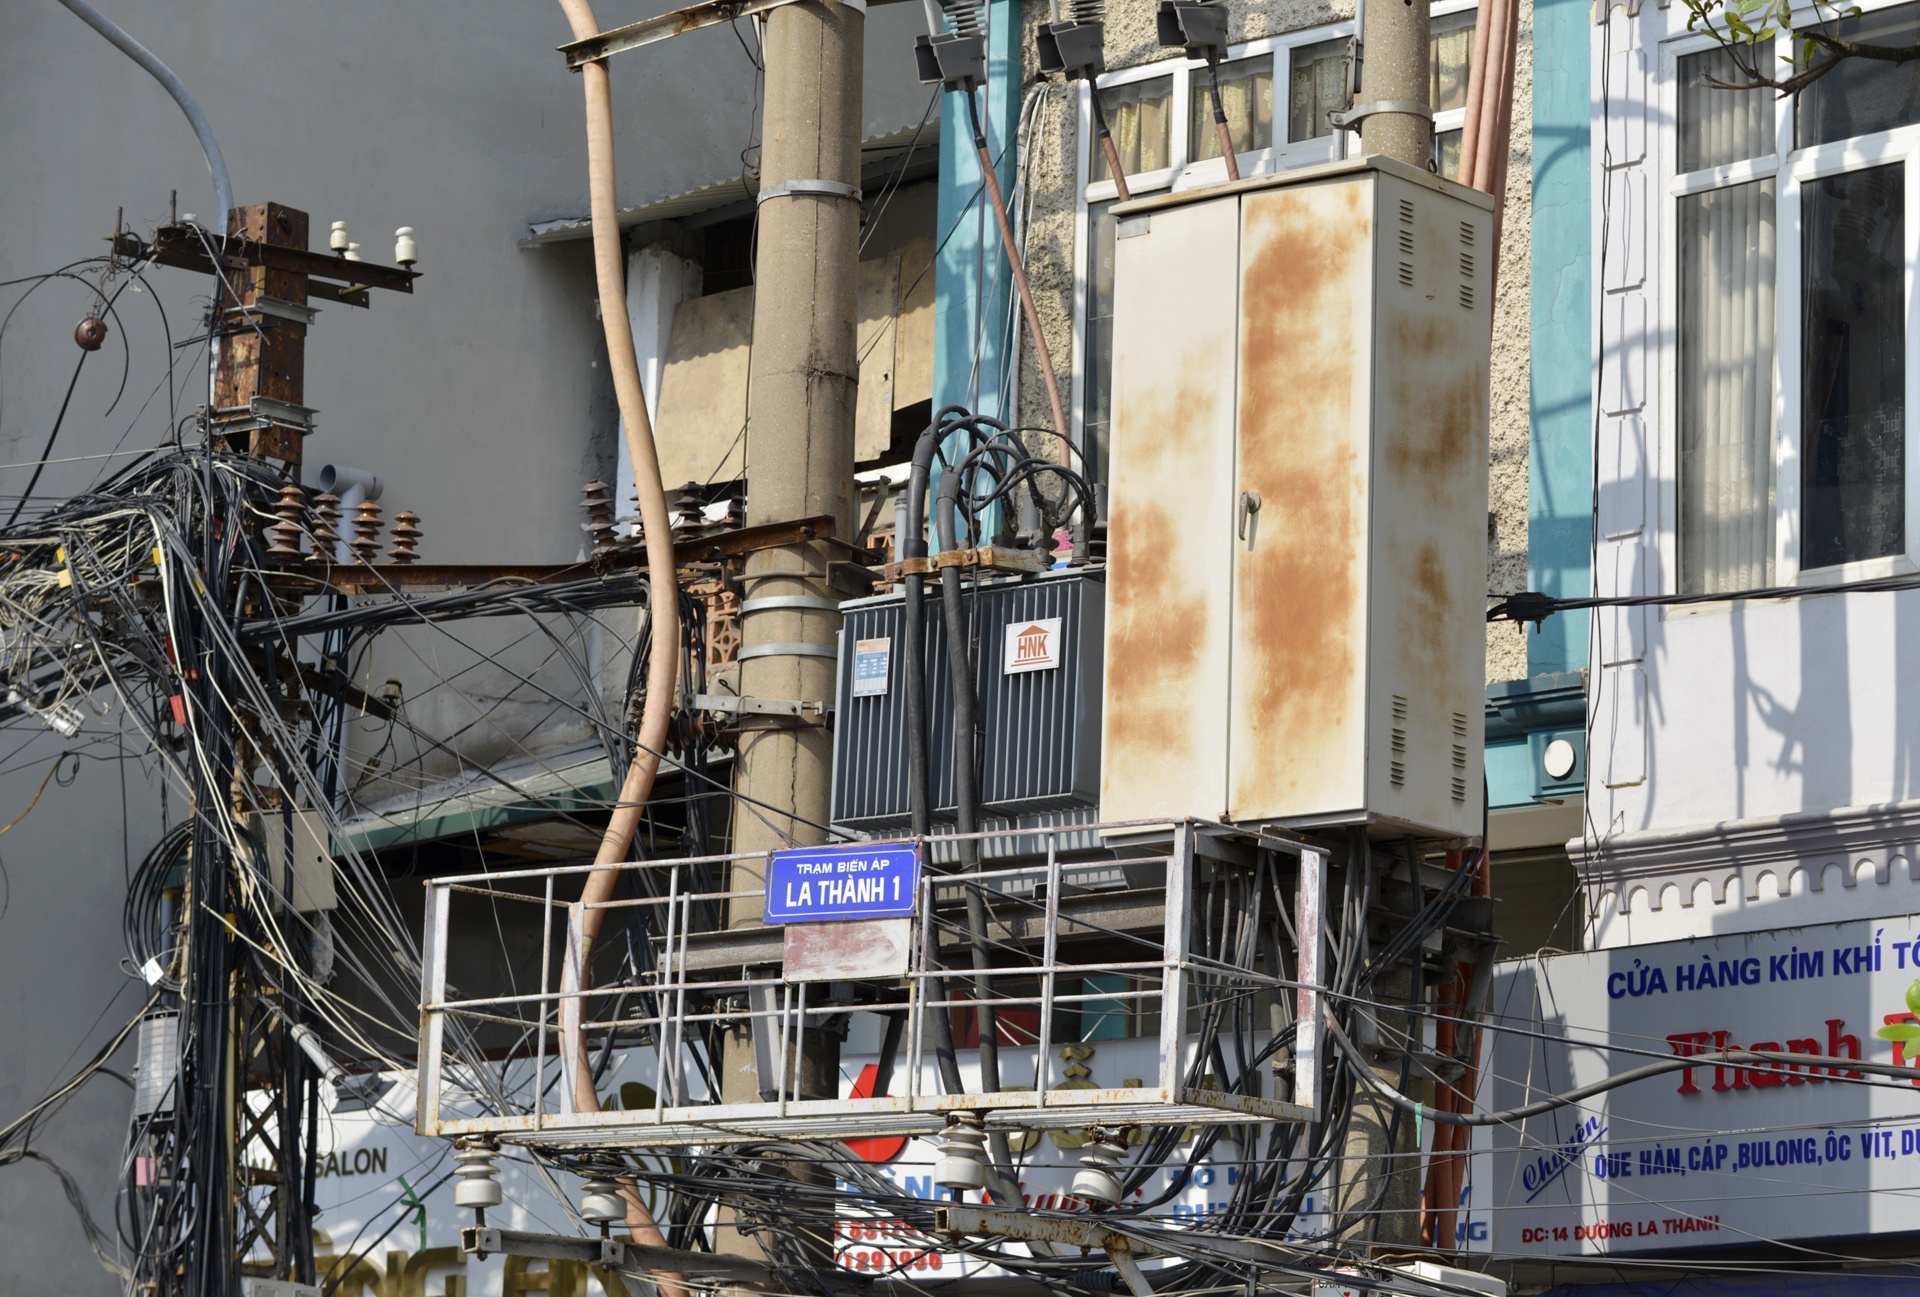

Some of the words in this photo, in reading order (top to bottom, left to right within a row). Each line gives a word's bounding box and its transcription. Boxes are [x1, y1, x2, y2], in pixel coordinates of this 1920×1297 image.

[1017, 634, 1048, 659] HNK
[797, 863, 833, 875] TRẠM
[837, 859, 868, 873] BIẾN
[871, 858, 890, 871] ÁP
[786, 881, 812, 908] LA
[818, 874, 885, 906] THÀNH
[892, 876, 900, 901] 1
[1607, 958, 1669, 999] CỬA
[1676, 954, 1761, 992] HÀNG
[1833, 928, 1885, 976] KHÍ
[1665, 1018, 1867, 1095] Thanh
[1594, 1151, 1632, 1182] QUE
[1552, 1226, 1569, 1241] 14
[1574, 1219, 1633, 1241] ĐƯỜNG
[1637, 1221, 1659, 1237] LA
